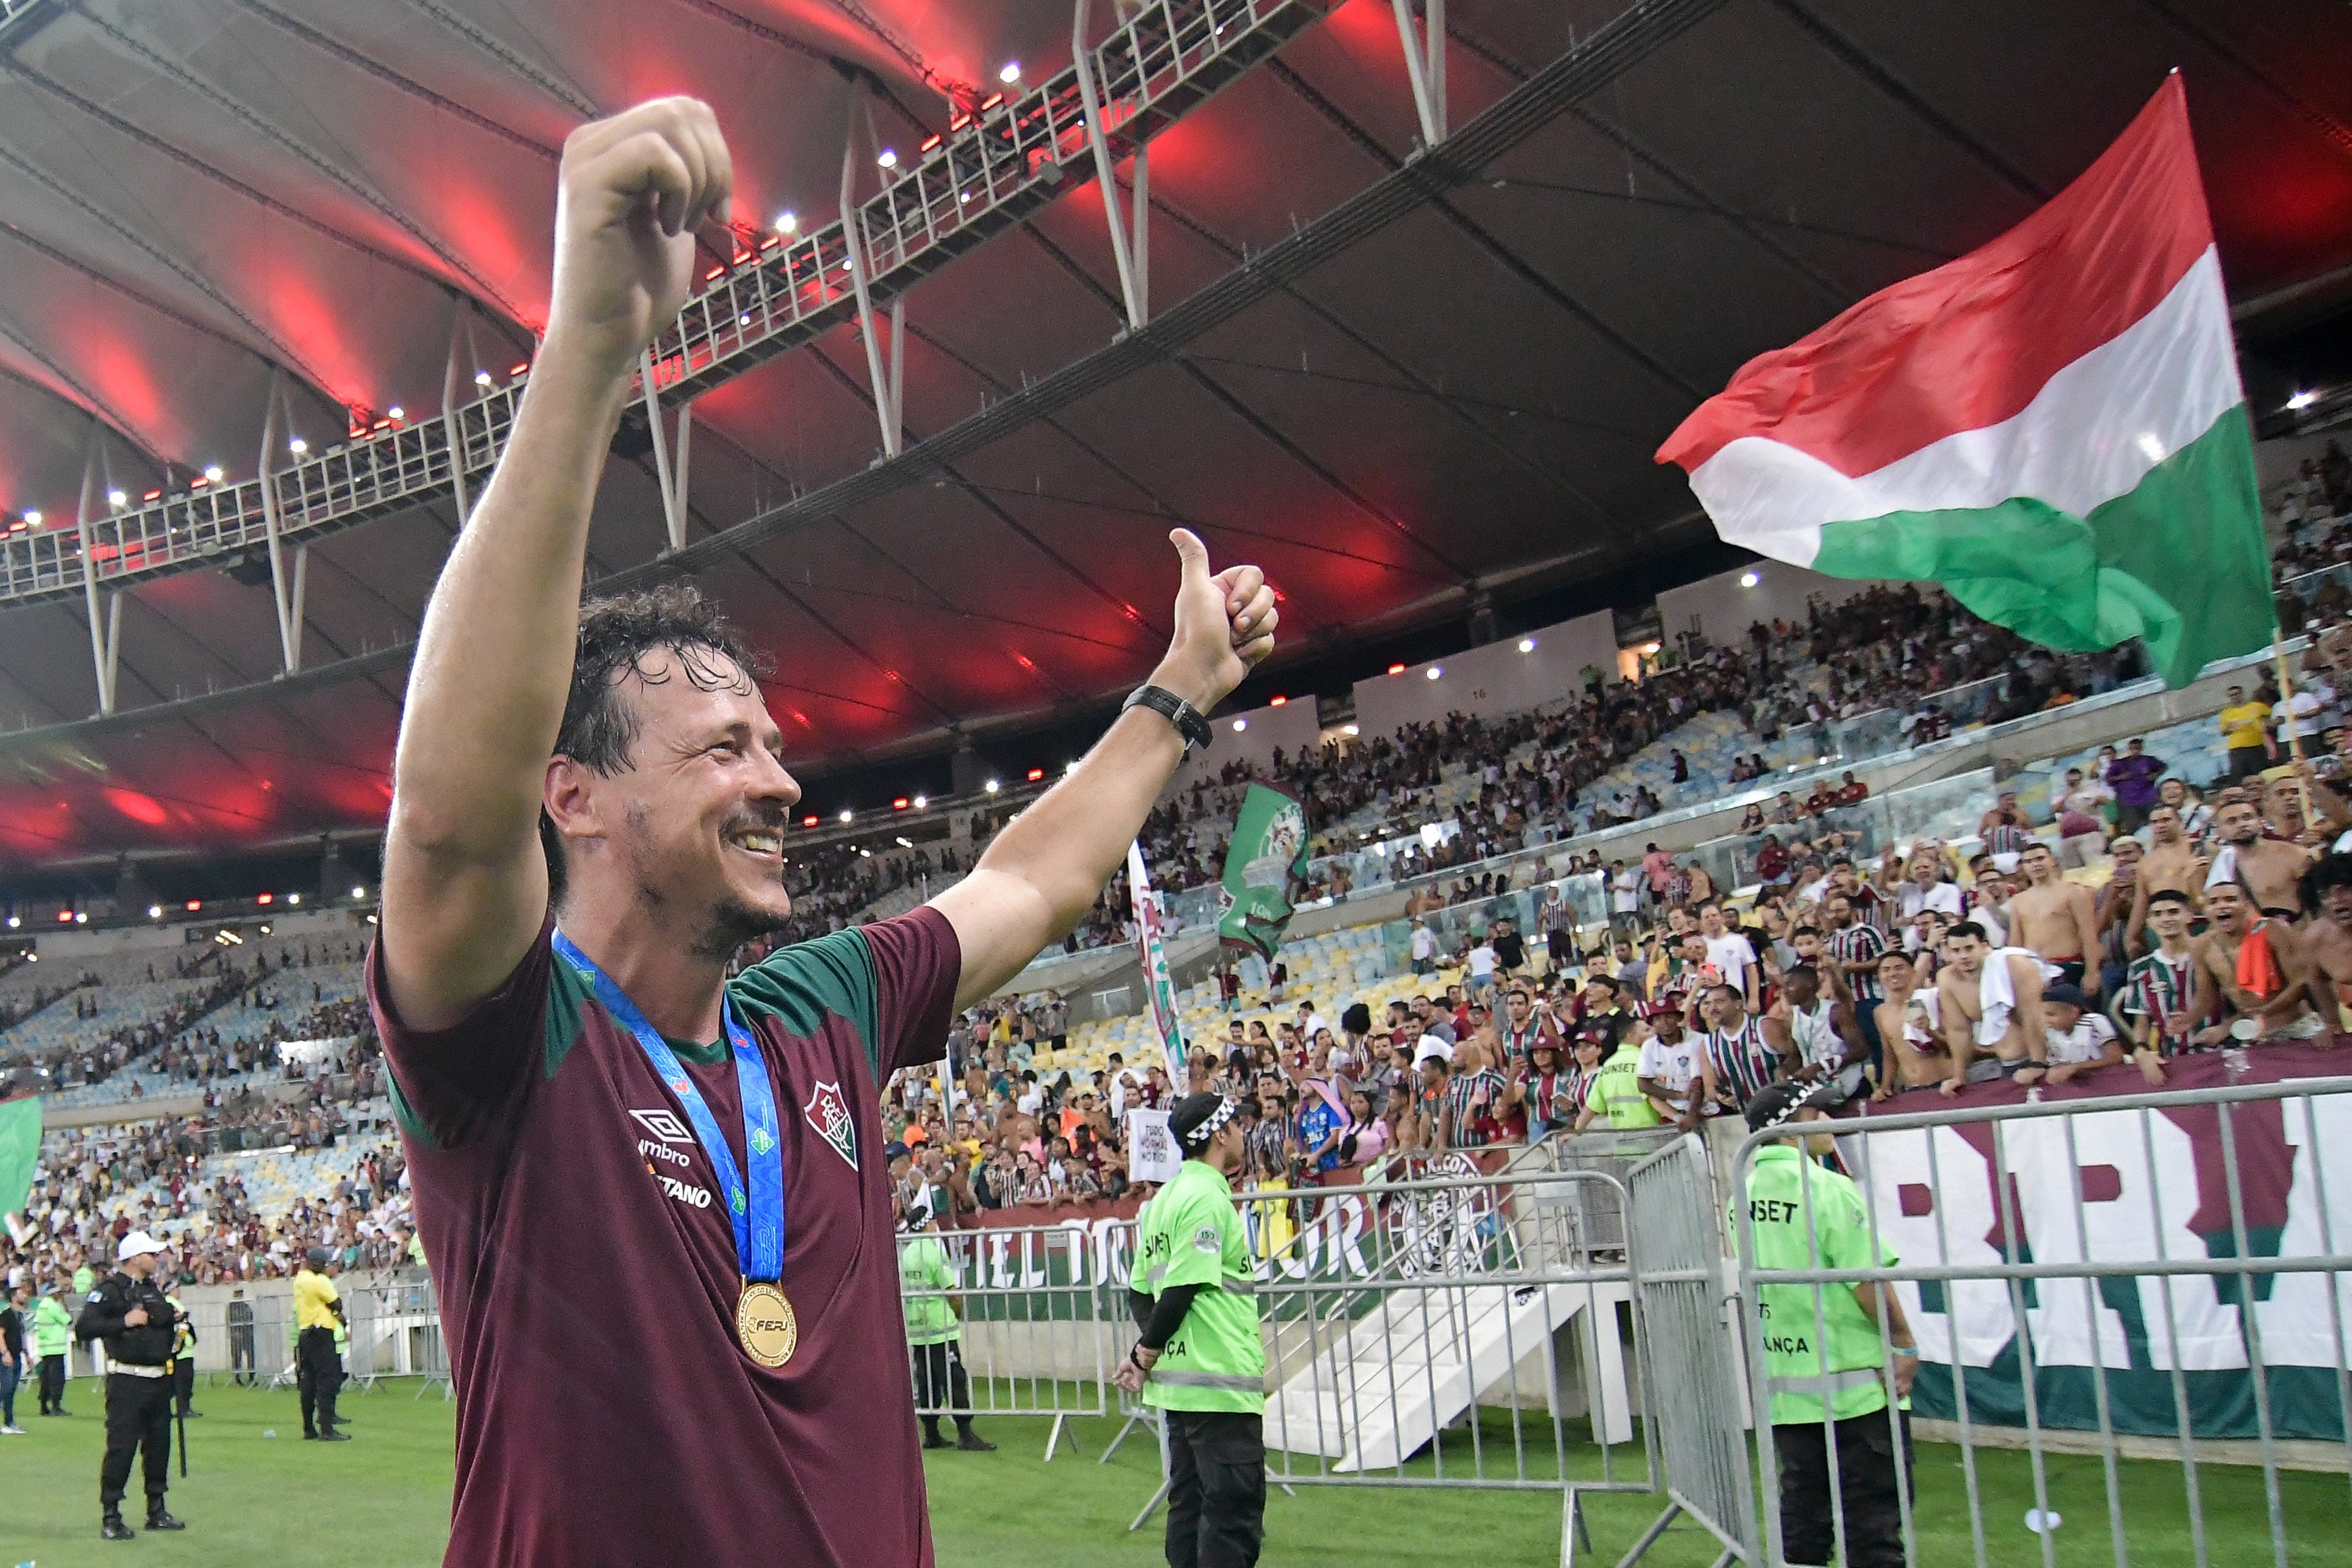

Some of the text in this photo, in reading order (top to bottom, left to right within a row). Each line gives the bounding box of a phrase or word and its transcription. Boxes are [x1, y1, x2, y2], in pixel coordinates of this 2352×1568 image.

[659, 1176, 711, 1208] TANO
[1837, 1077, 2352, 1372] BR
[756, 1320, 788, 1332] FERJ
